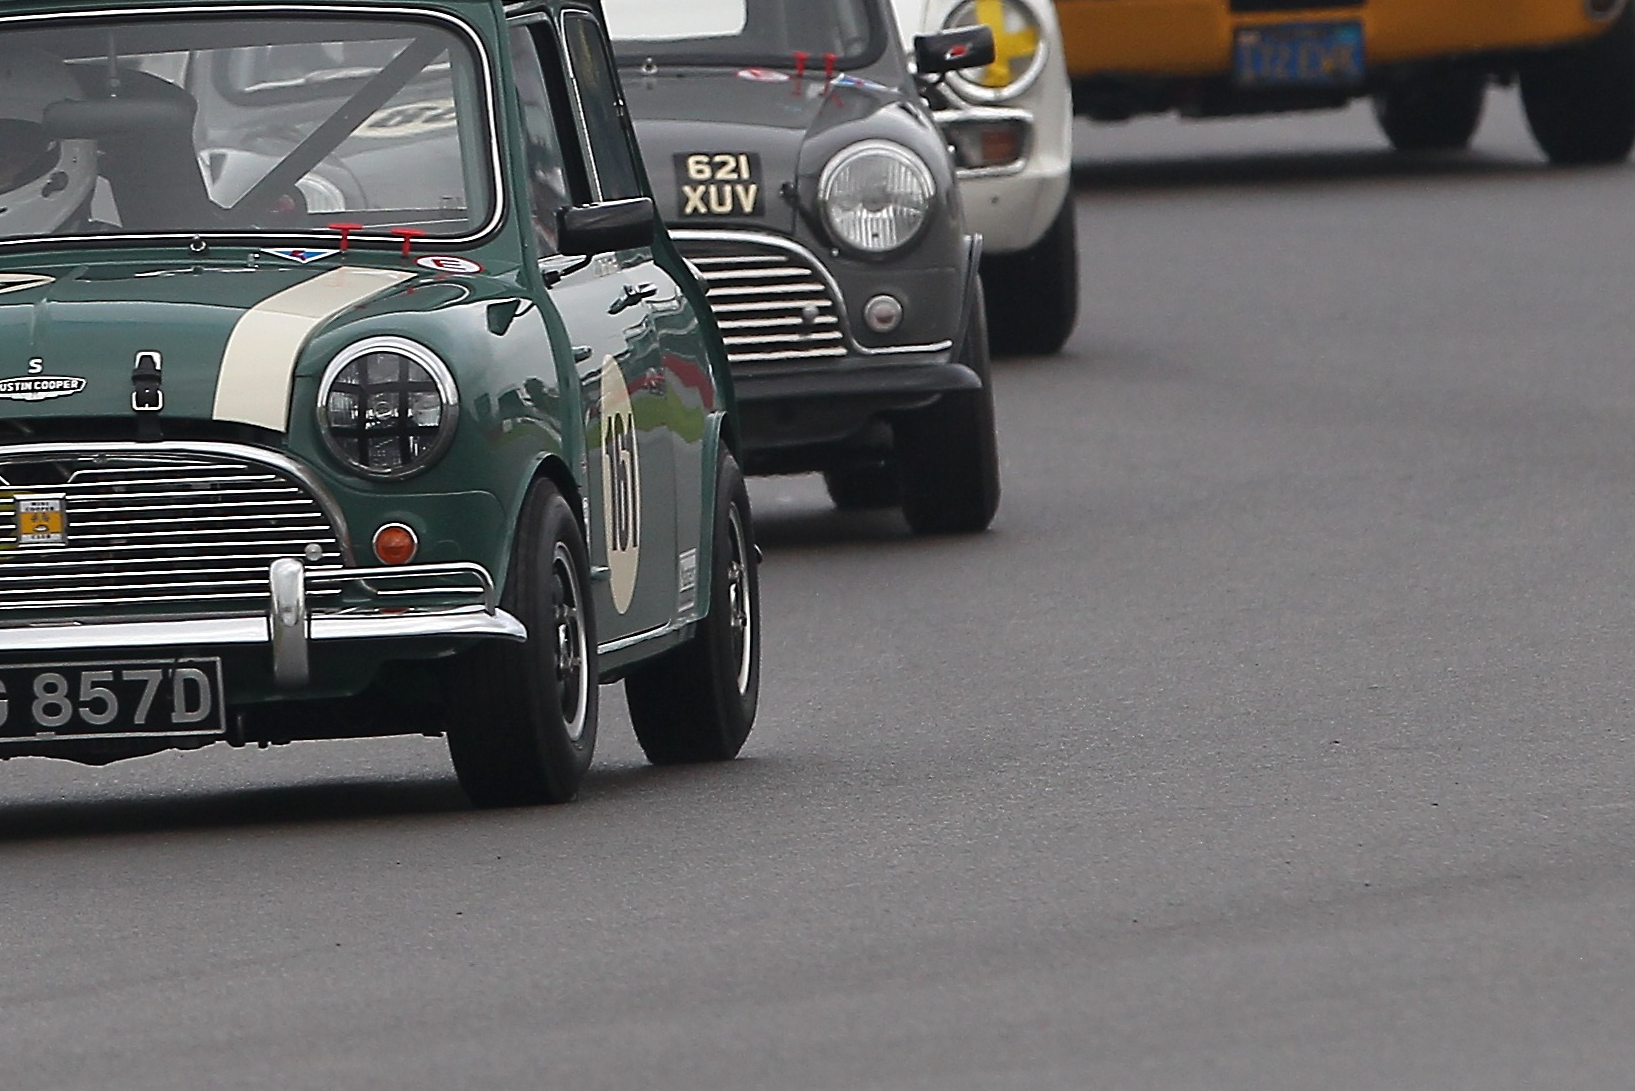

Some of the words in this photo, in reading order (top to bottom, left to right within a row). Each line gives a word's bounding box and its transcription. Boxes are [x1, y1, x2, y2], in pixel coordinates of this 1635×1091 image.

[687, 153, 750, 180] 621
[681, 183, 757, 215] XUV
[27, 358, 43, 374] S
[33, 379, 78, 390] COOPER
[604, 412, 638, 552] 161
[31, 668, 211, 727] 857D
